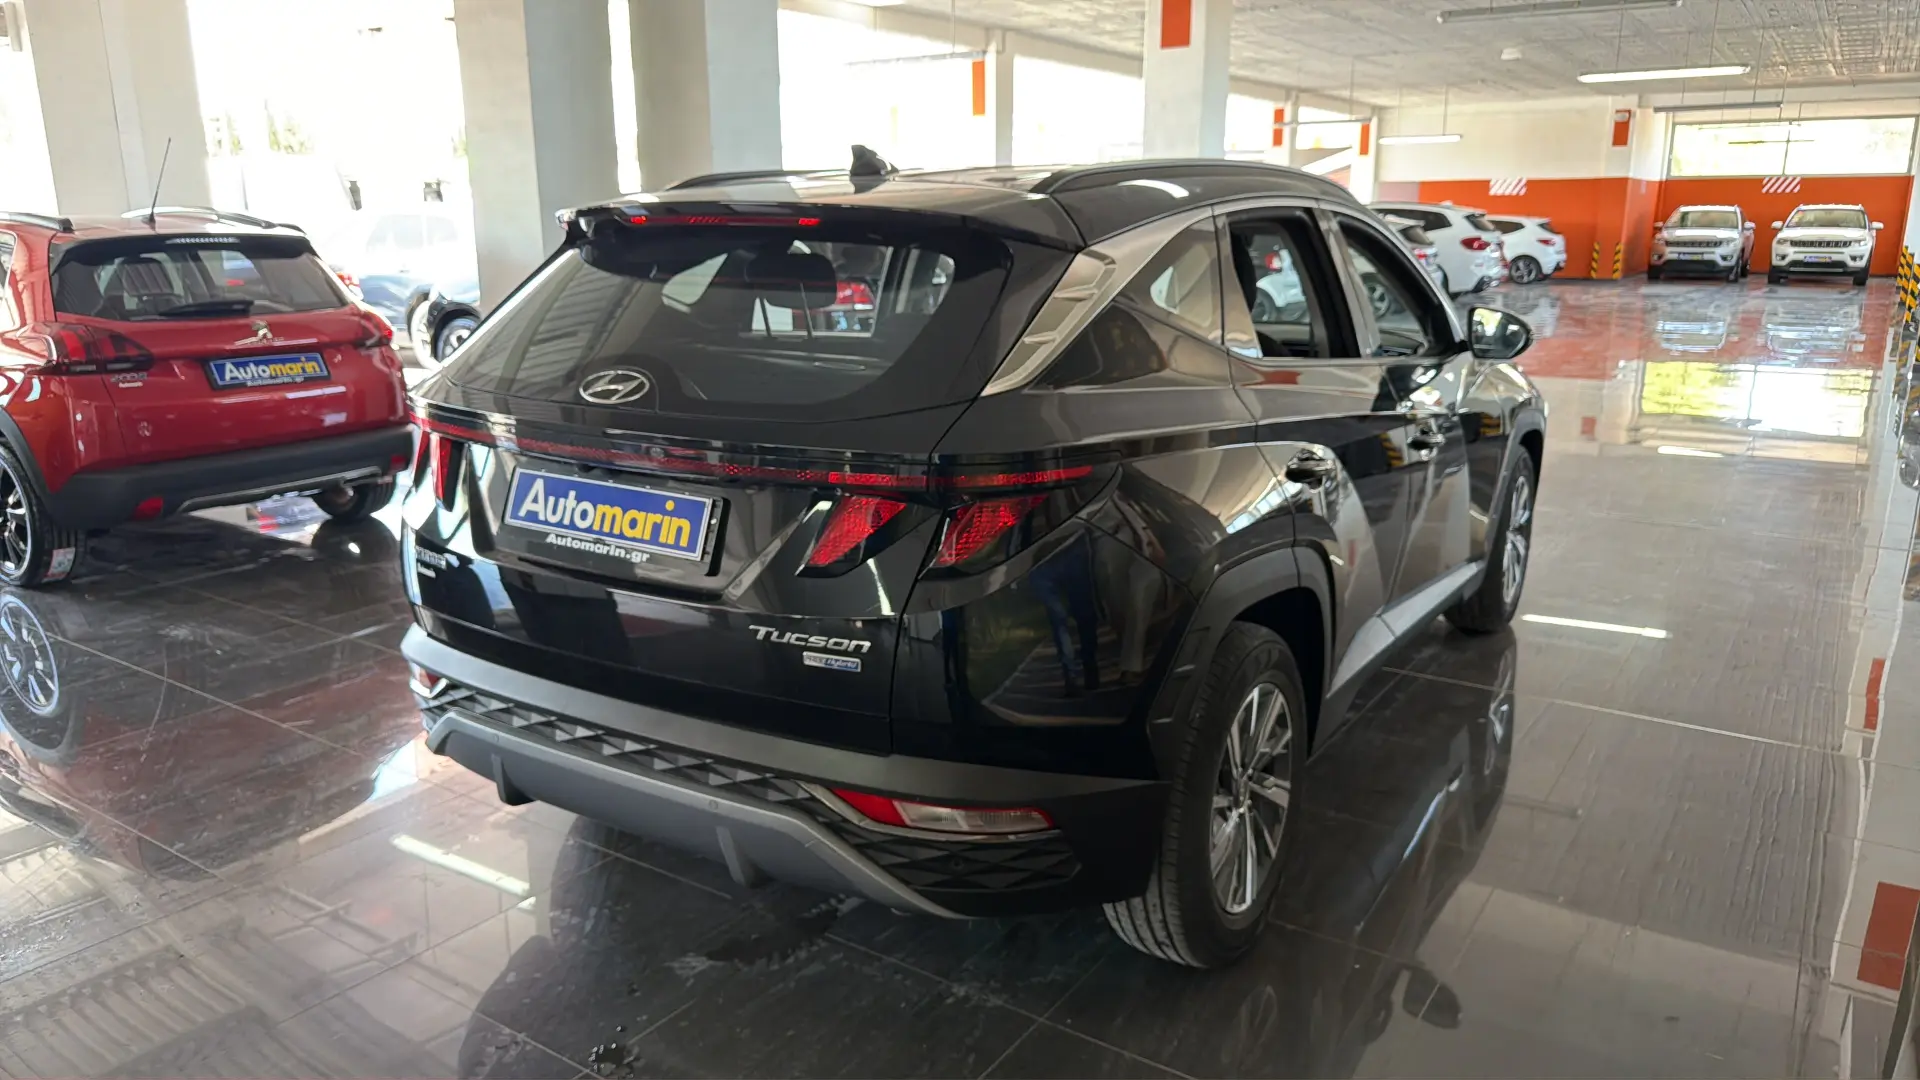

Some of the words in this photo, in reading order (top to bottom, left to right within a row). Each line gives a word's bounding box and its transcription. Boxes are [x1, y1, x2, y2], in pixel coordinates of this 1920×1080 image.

[225, 356, 320, 381] Automarin
[517, 478, 691, 548] Automarin
[546, 533, 650, 564] Automarin.gr
